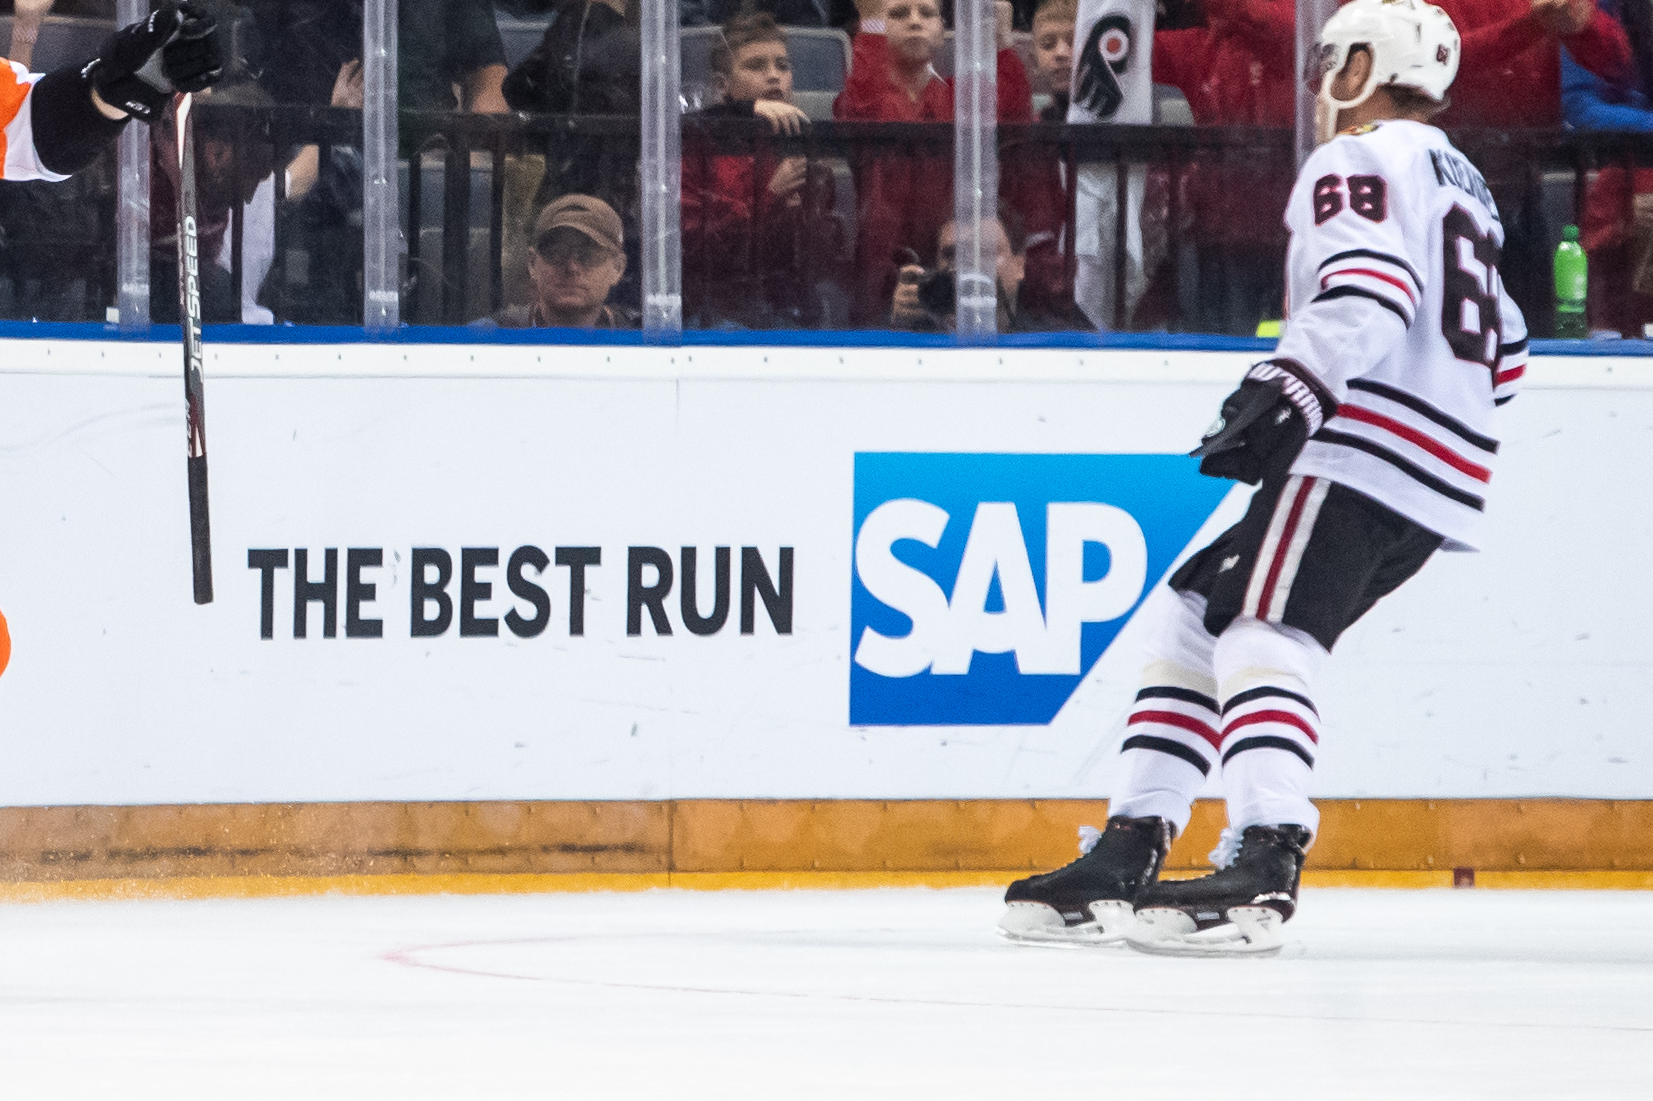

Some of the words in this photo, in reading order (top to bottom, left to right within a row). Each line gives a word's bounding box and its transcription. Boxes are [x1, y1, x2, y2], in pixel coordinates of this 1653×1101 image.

[1312, 173, 1388, 227] 68
[185, 215, 204, 384] JETSPEED
[248, 547, 383, 640] THE
[410, 544, 602, 639] BEST
[626, 545, 794, 637] RUN
[853, 497, 1148, 679] SAP
